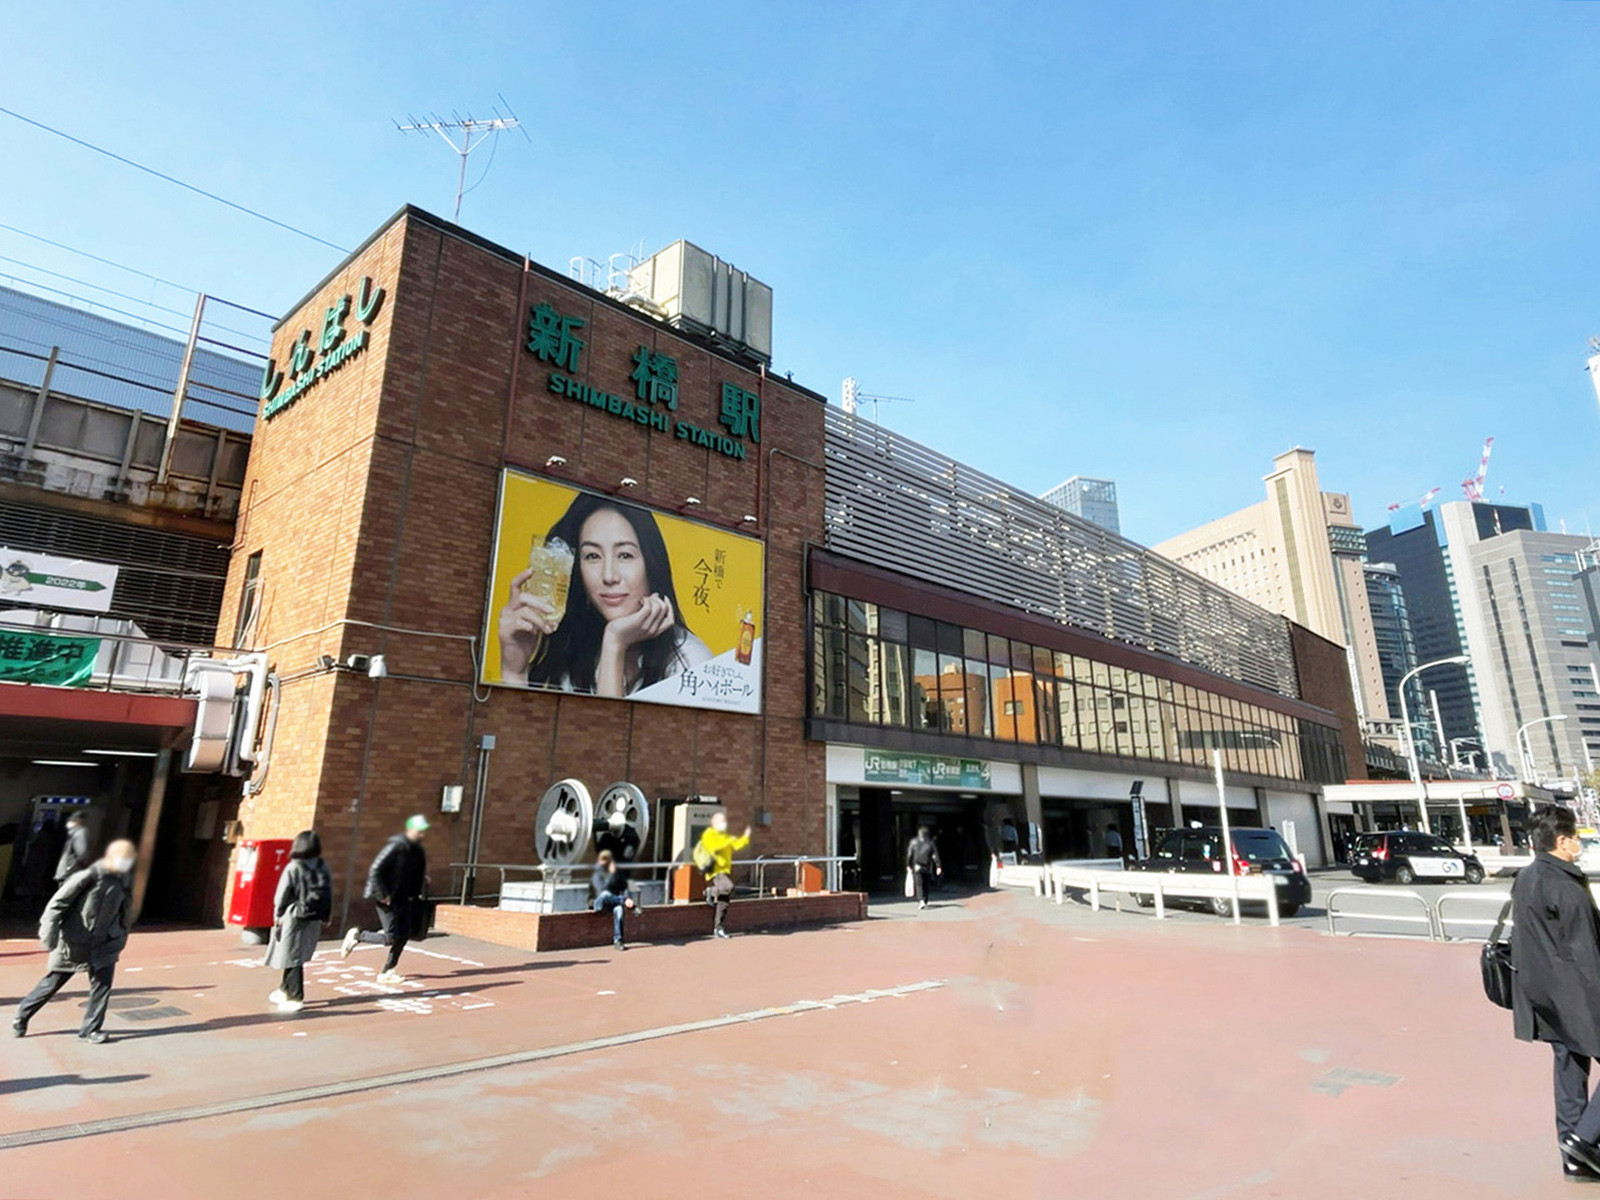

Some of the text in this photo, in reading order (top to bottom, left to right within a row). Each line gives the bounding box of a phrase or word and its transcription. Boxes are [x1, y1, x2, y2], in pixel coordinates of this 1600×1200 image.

[260, 276, 386, 399] しんばし
[315, 330, 370, 379] STATION
[527, 302, 761, 443] 新橋駅
[549, 373, 746, 460] SHIMBASHI STATION
[44, 576, 87, 589] 2022年
[678, 667, 755, 697] 角ハイボール
[865, 756, 880, 771] JR
[932, 762, 945, 775] JR
